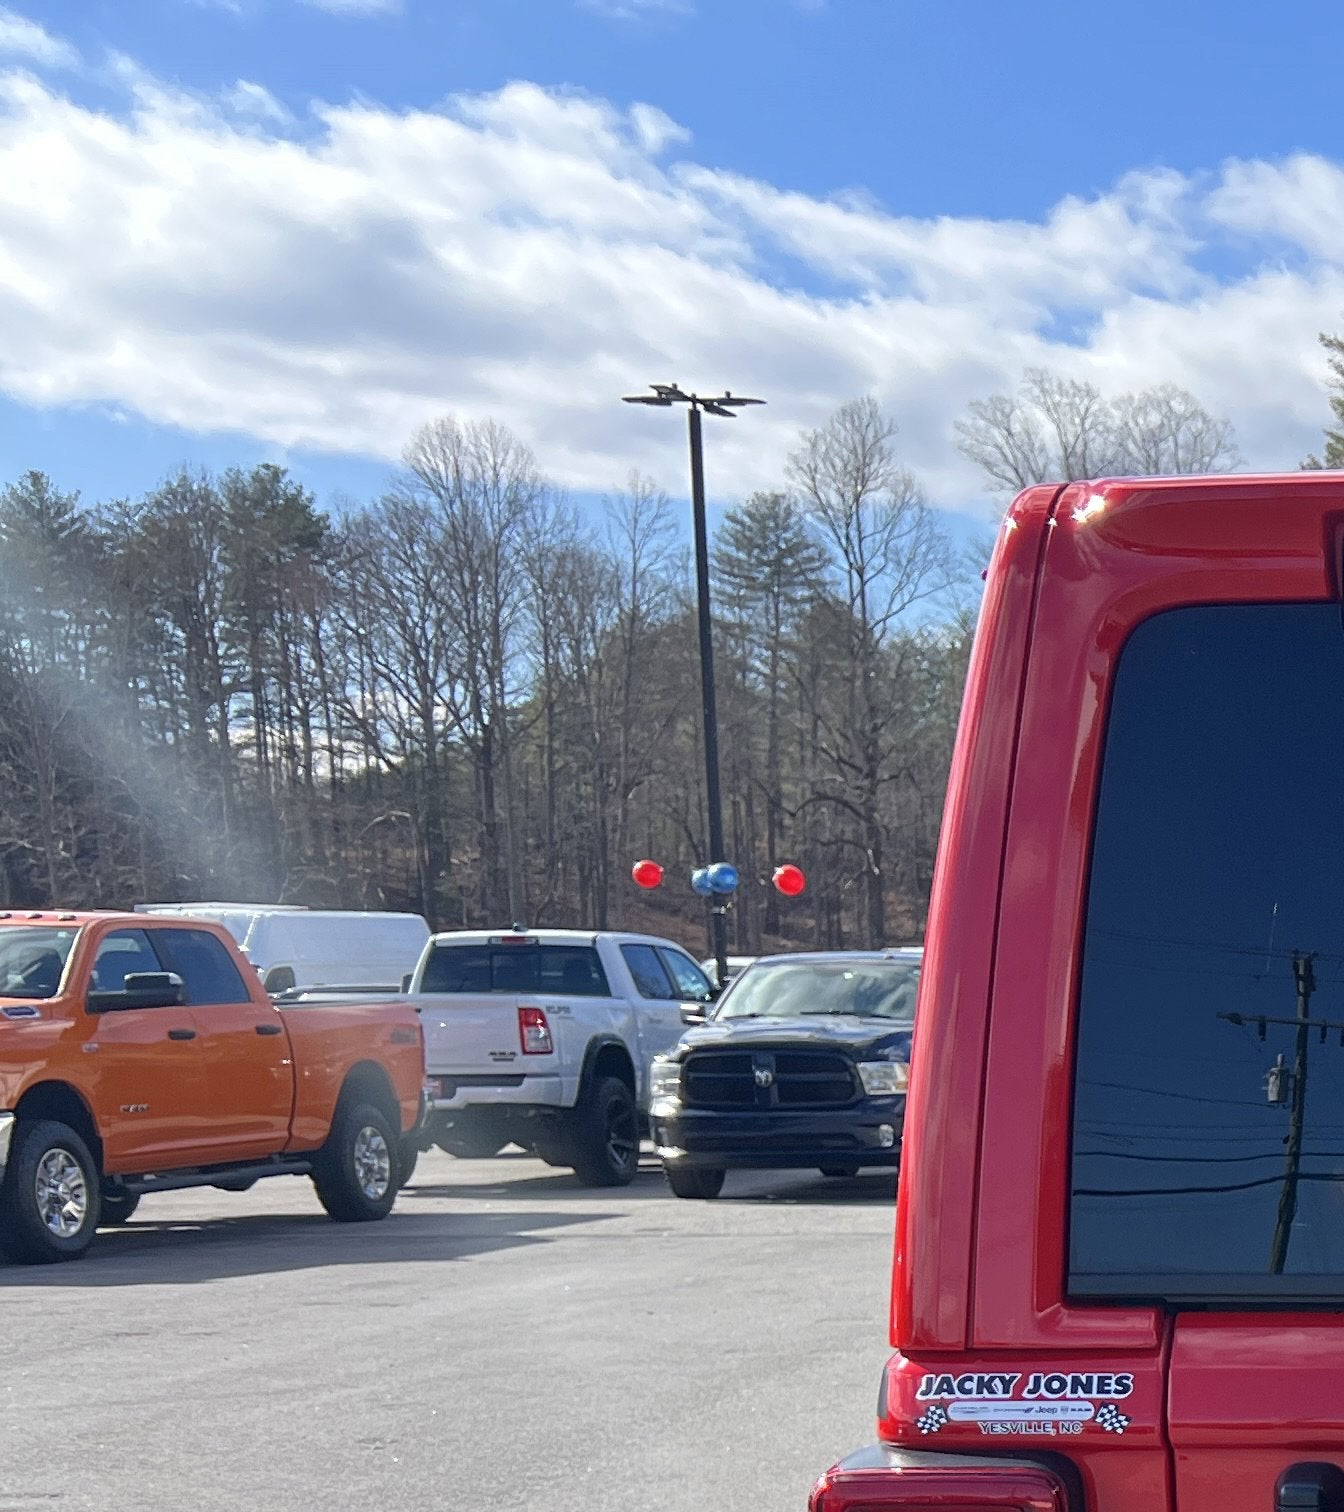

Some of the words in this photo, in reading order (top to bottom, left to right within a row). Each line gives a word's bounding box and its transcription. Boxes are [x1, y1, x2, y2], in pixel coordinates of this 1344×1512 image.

[916, 1373, 1021, 1398] JACKY
[1023, 1373, 1133, 1398] JONES
[1061, 1421, 1083, 1435] NC
